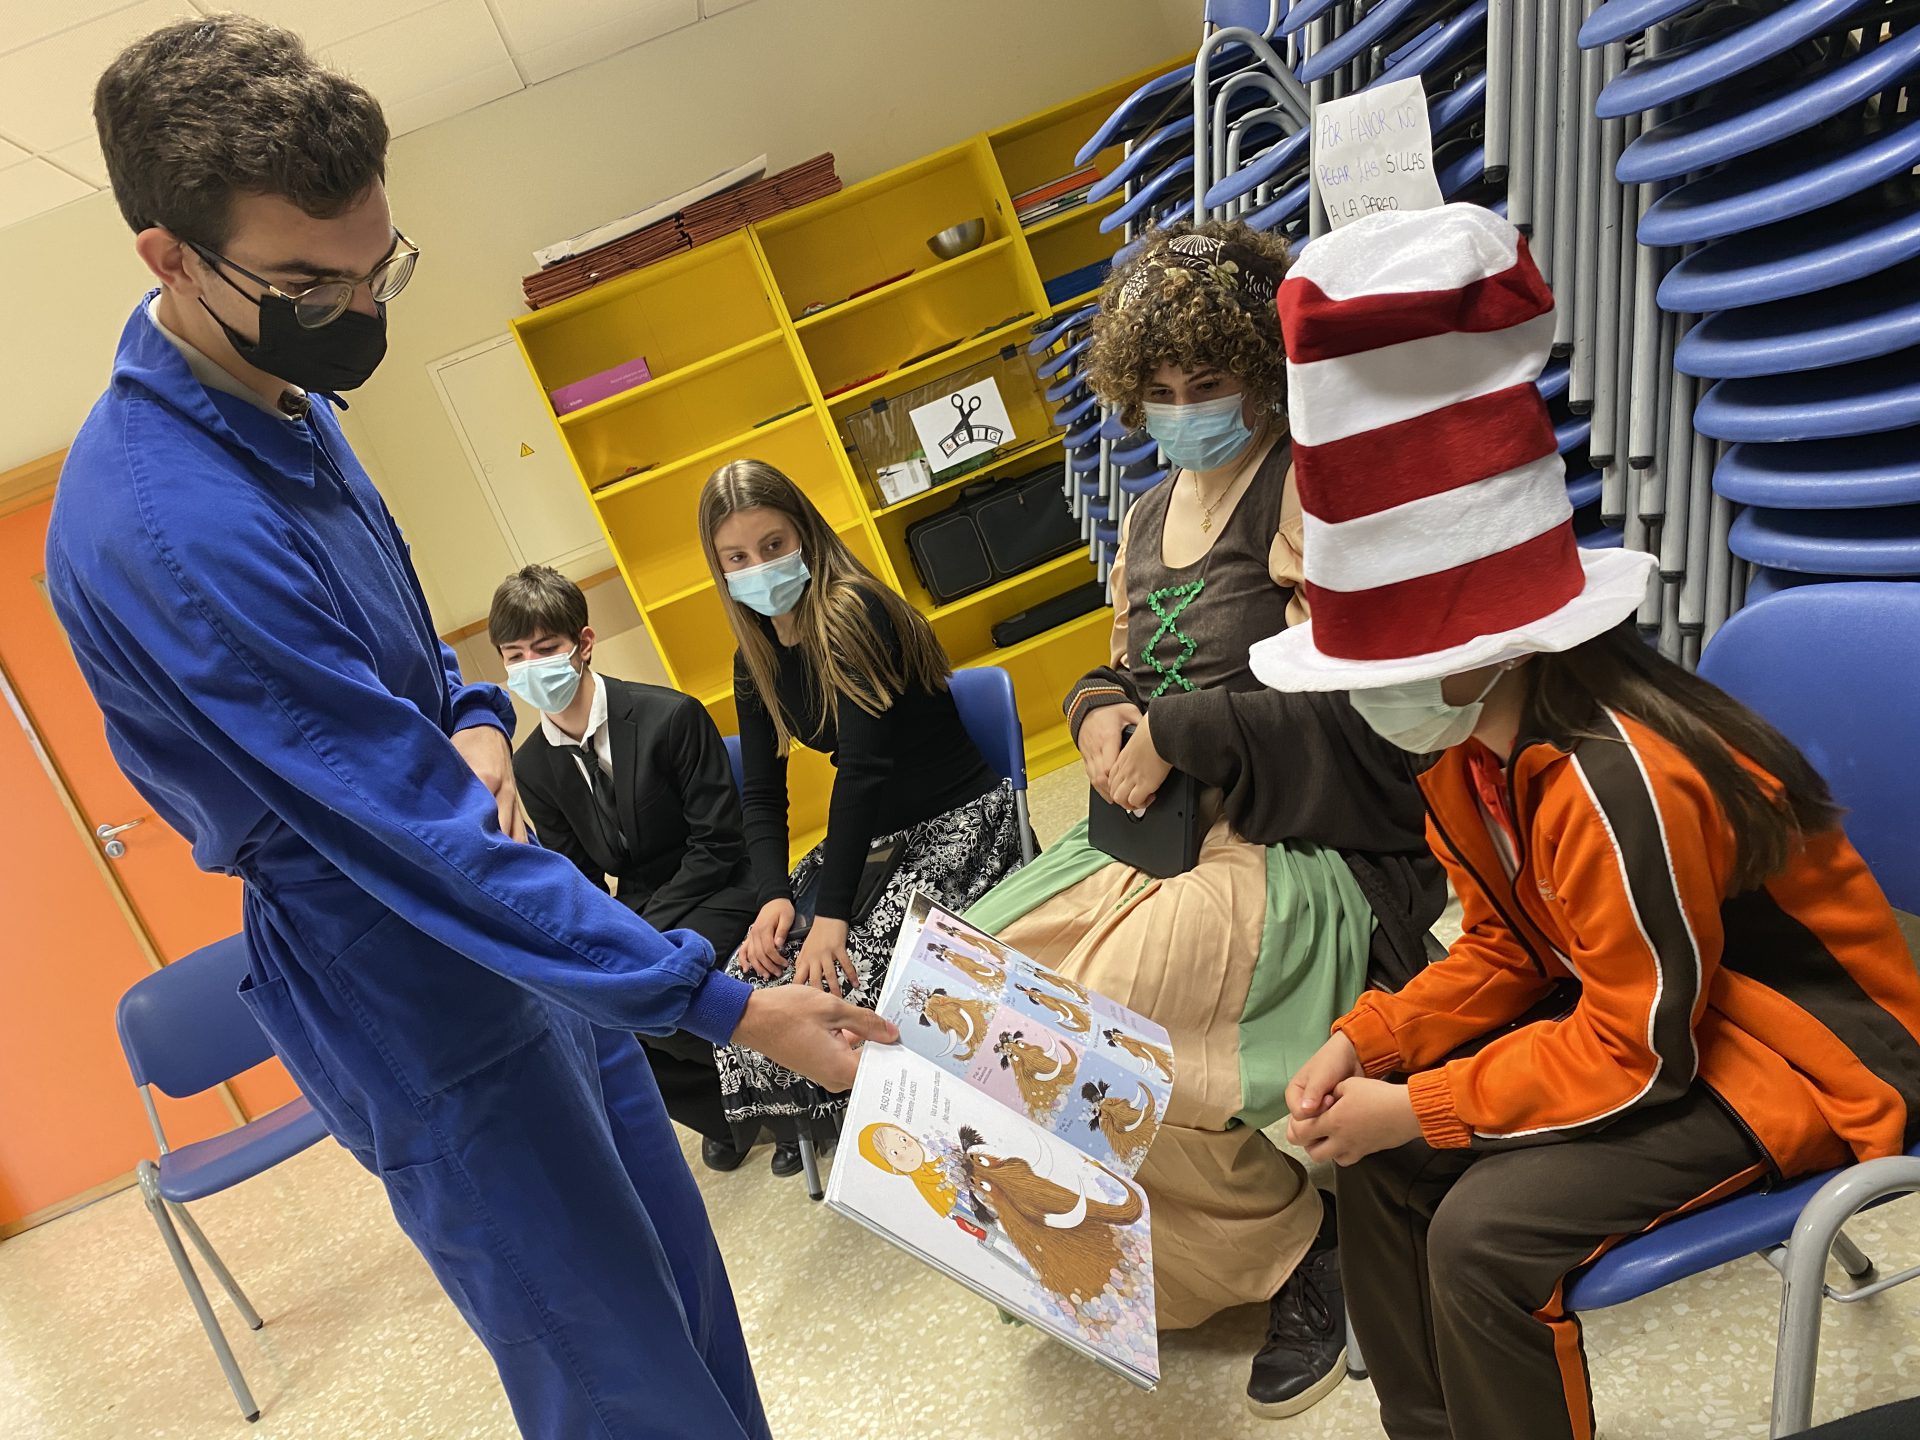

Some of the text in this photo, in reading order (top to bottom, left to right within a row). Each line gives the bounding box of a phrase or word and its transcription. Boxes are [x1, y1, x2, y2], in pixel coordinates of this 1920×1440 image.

[1321, 106, 1416, 149] POR FAVOR NO
[1319, 164, 1352, 189] PEGAR
[1330, 204, 1341, 224] A
[1342, 198, 1359, 218] LA
